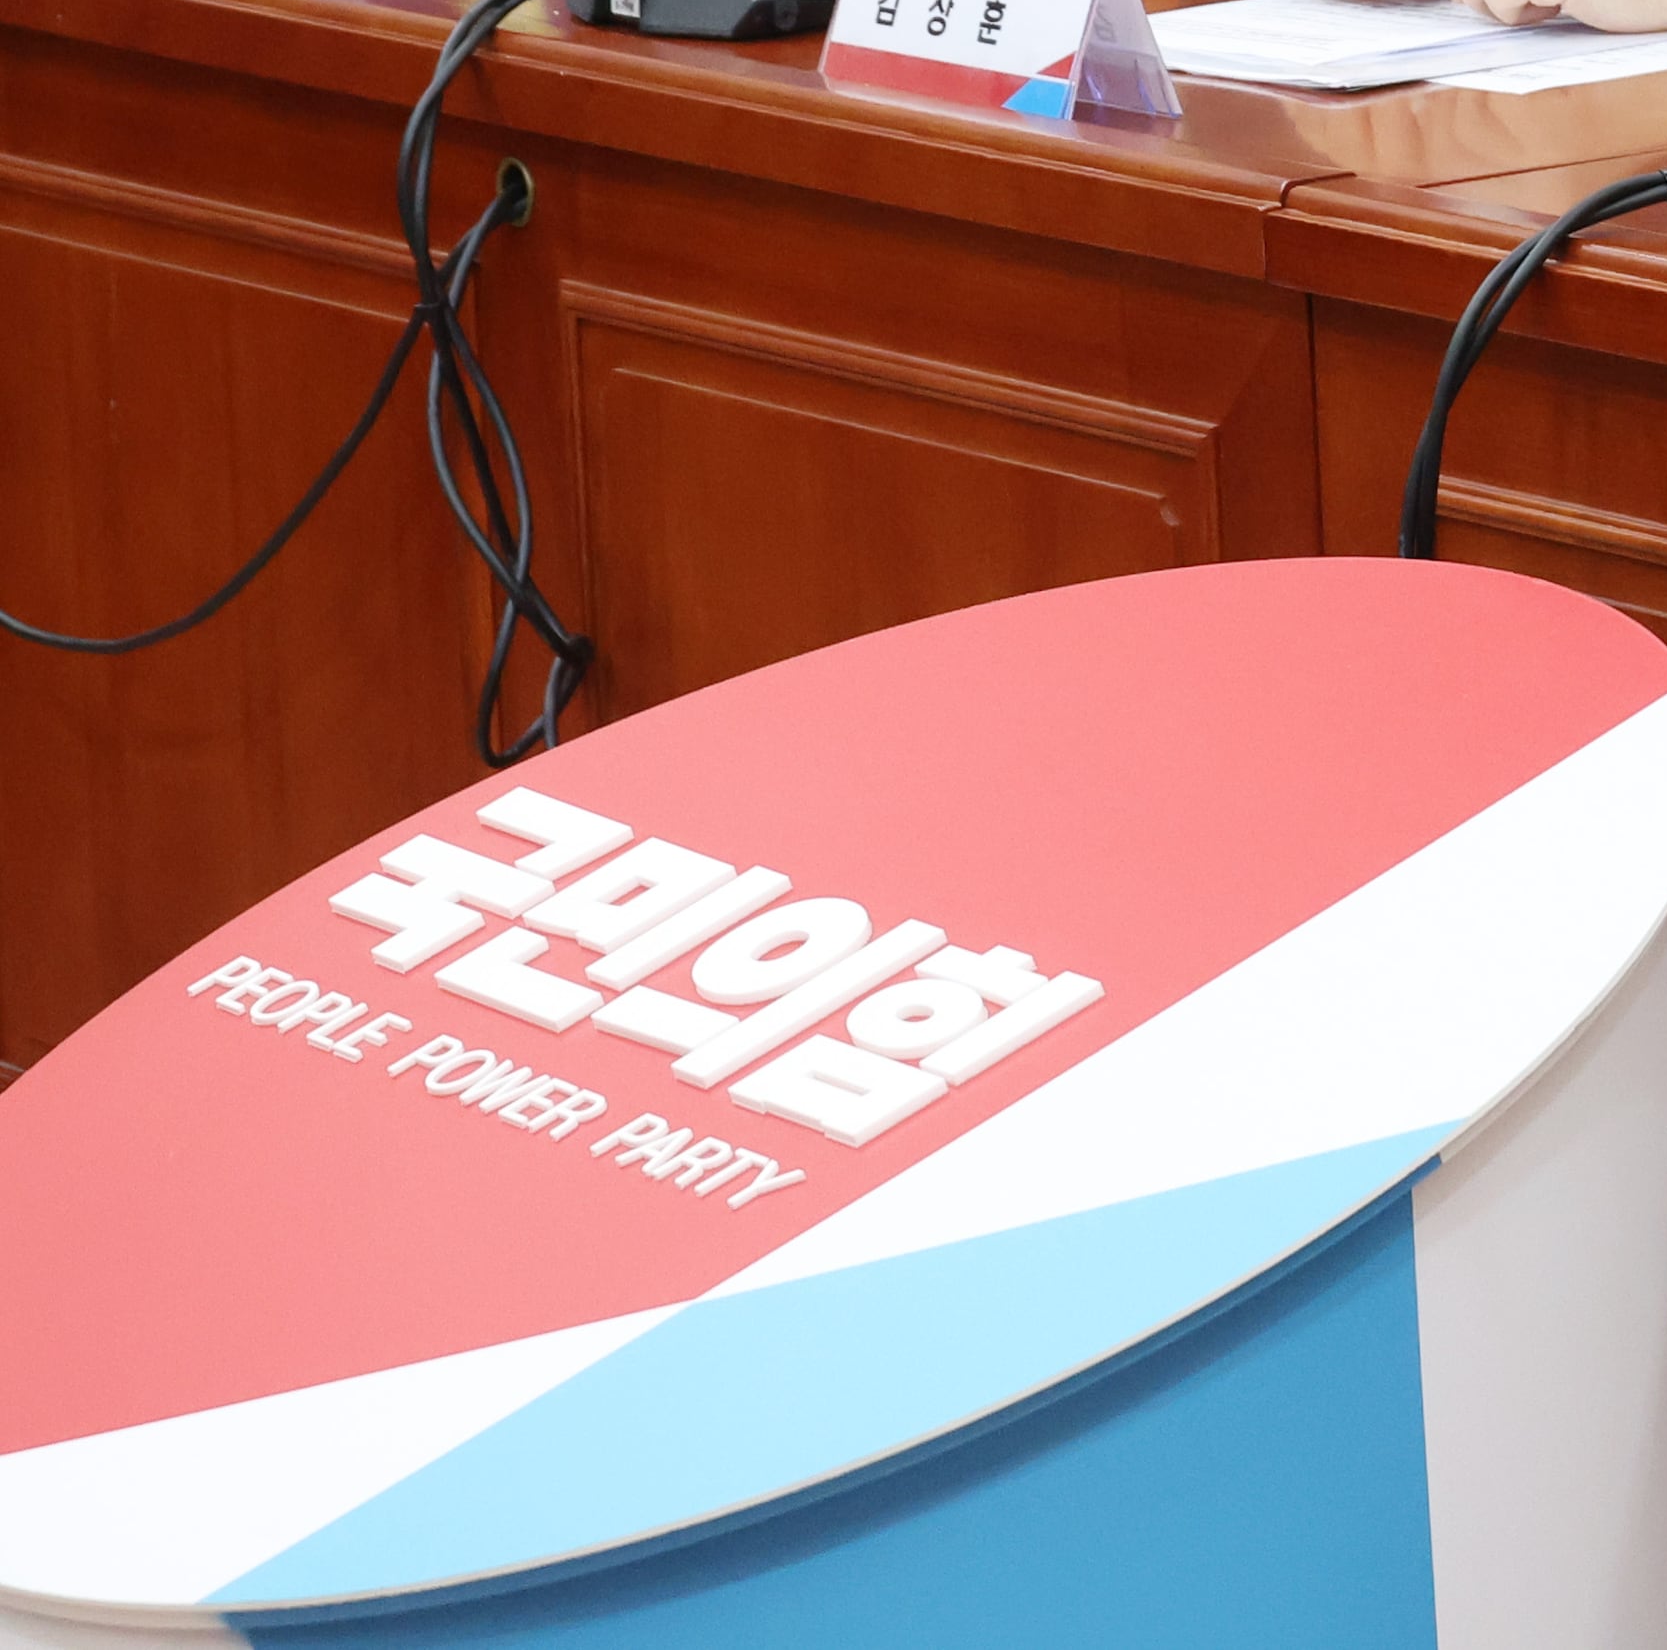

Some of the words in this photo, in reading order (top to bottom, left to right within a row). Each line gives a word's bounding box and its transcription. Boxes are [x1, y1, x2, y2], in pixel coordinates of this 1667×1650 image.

[187, 955, 412, 1062] PEOPLE
[387, 1035, 606, 1141] POWER
[590, 1112, 806, 1211] PARTY
[329, 786, 1104, 1148] 국민의힘
